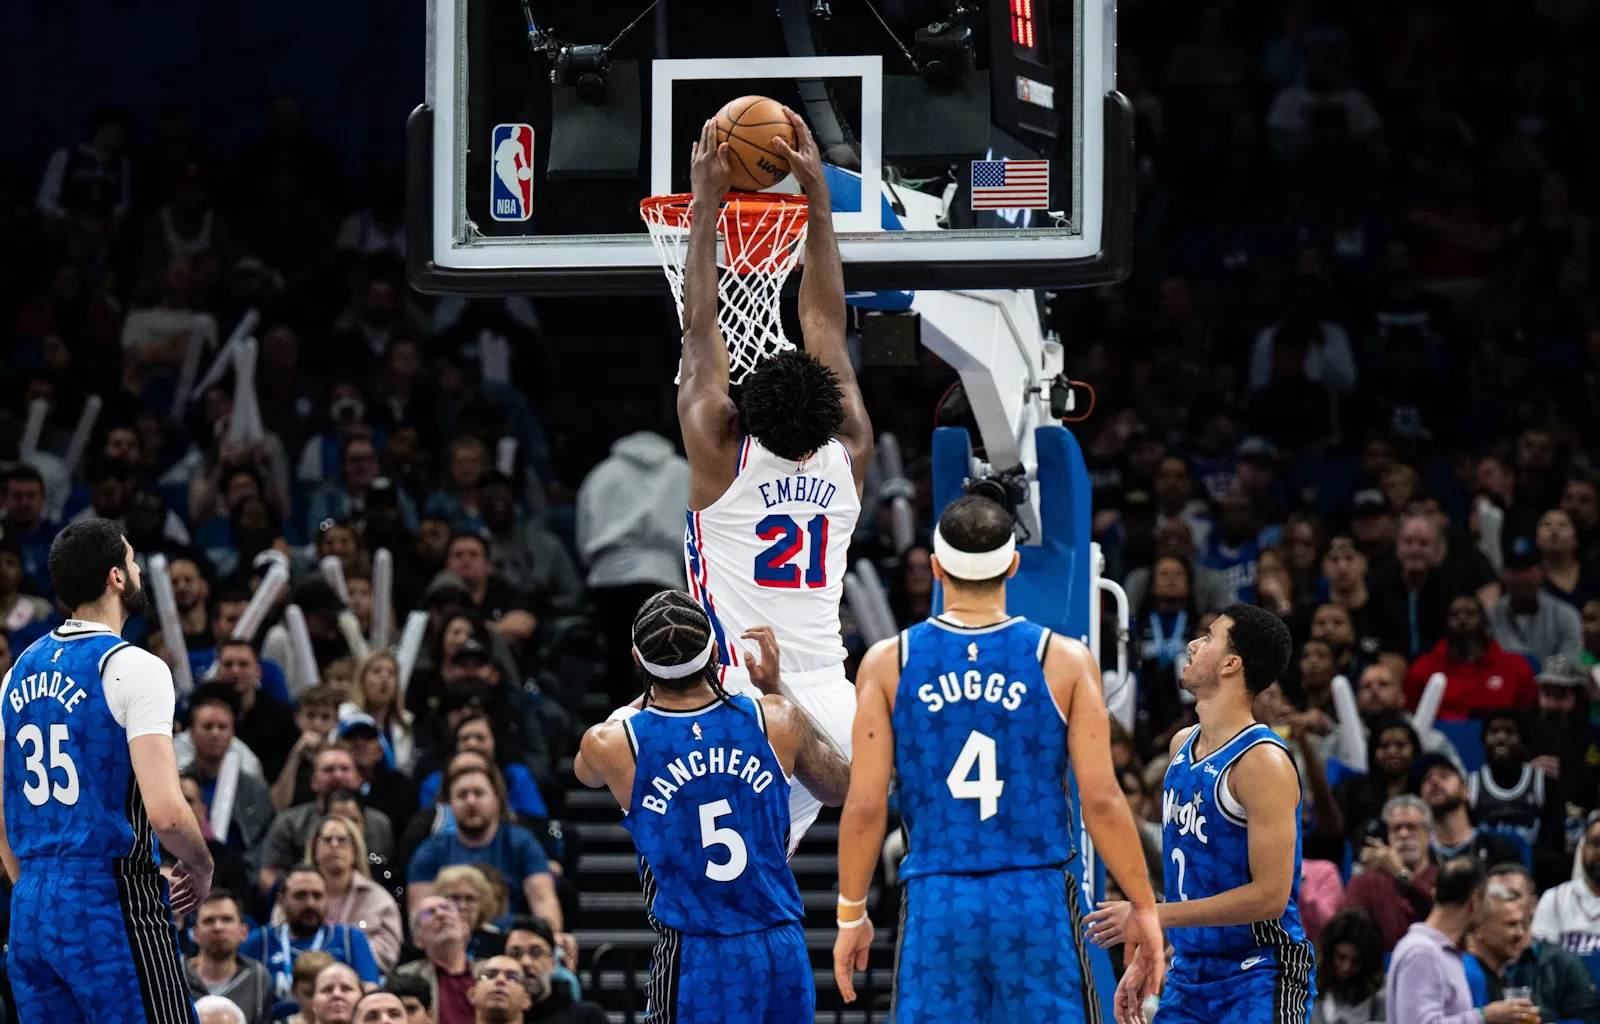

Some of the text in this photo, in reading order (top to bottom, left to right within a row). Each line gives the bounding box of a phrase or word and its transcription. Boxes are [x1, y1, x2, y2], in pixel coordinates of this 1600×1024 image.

[497, 199, 517, 215] NBA
[758, 476, 836, 509] EMBIID
[754, 514, 829, 589] 21
[9, 671, 87, 713] BITADZE
[918, 669, 1027, 712] SUGGS
[15, 723, 80, 806] 35
[641, 747, 773, 815] BANCHERO
[946, 729, 1004, 822] 4
[698, 798, 748, 882] 5
